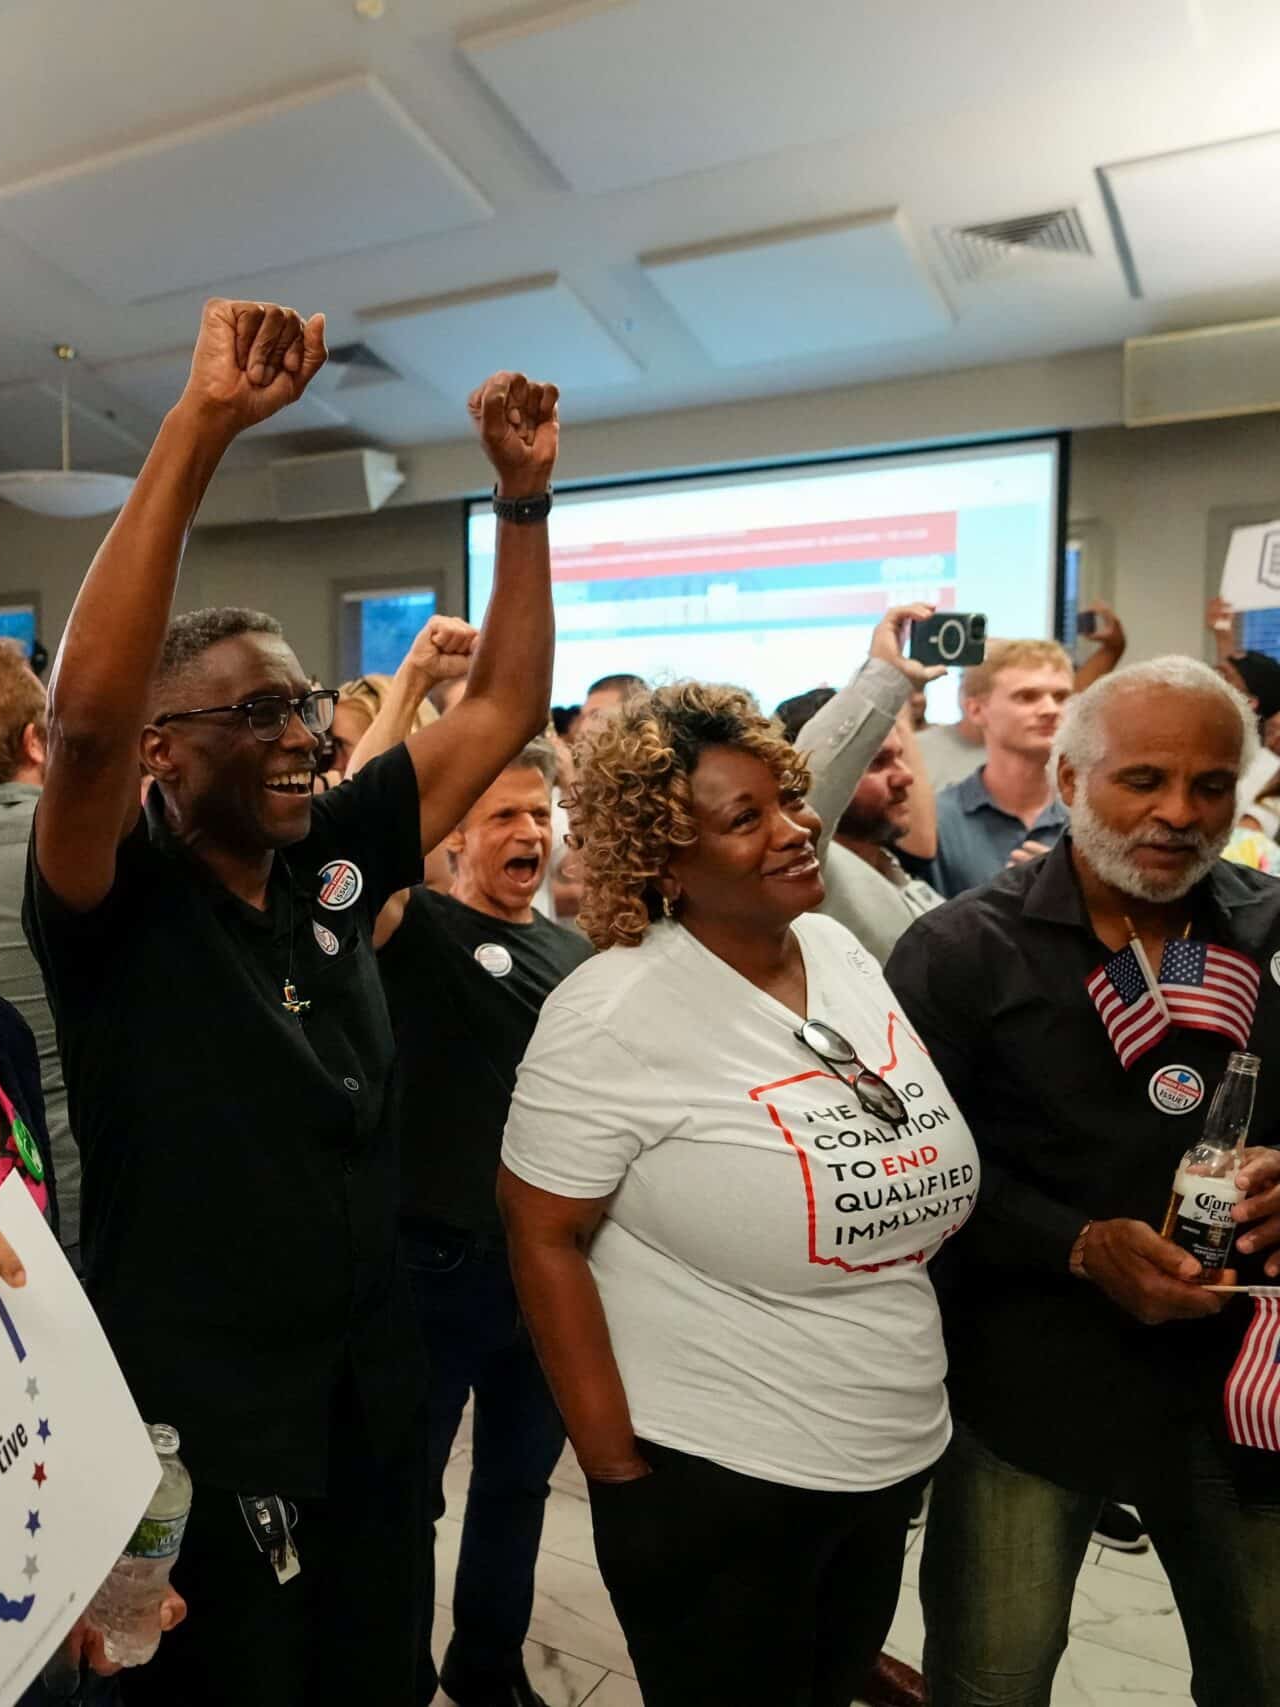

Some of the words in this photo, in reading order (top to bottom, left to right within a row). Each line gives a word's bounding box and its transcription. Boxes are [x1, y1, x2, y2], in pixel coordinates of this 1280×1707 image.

[814, 1105, 951, 1151] COALITION
[827, 1161, 876, 1182] TO
[880, 1145, 939, 1176] END
[835, 1164, 974, 1213] QUALIFIED
[835, 1189, 976, 1246] IMMUNITY
[1209, 1210, 1234, 1222] Extr
